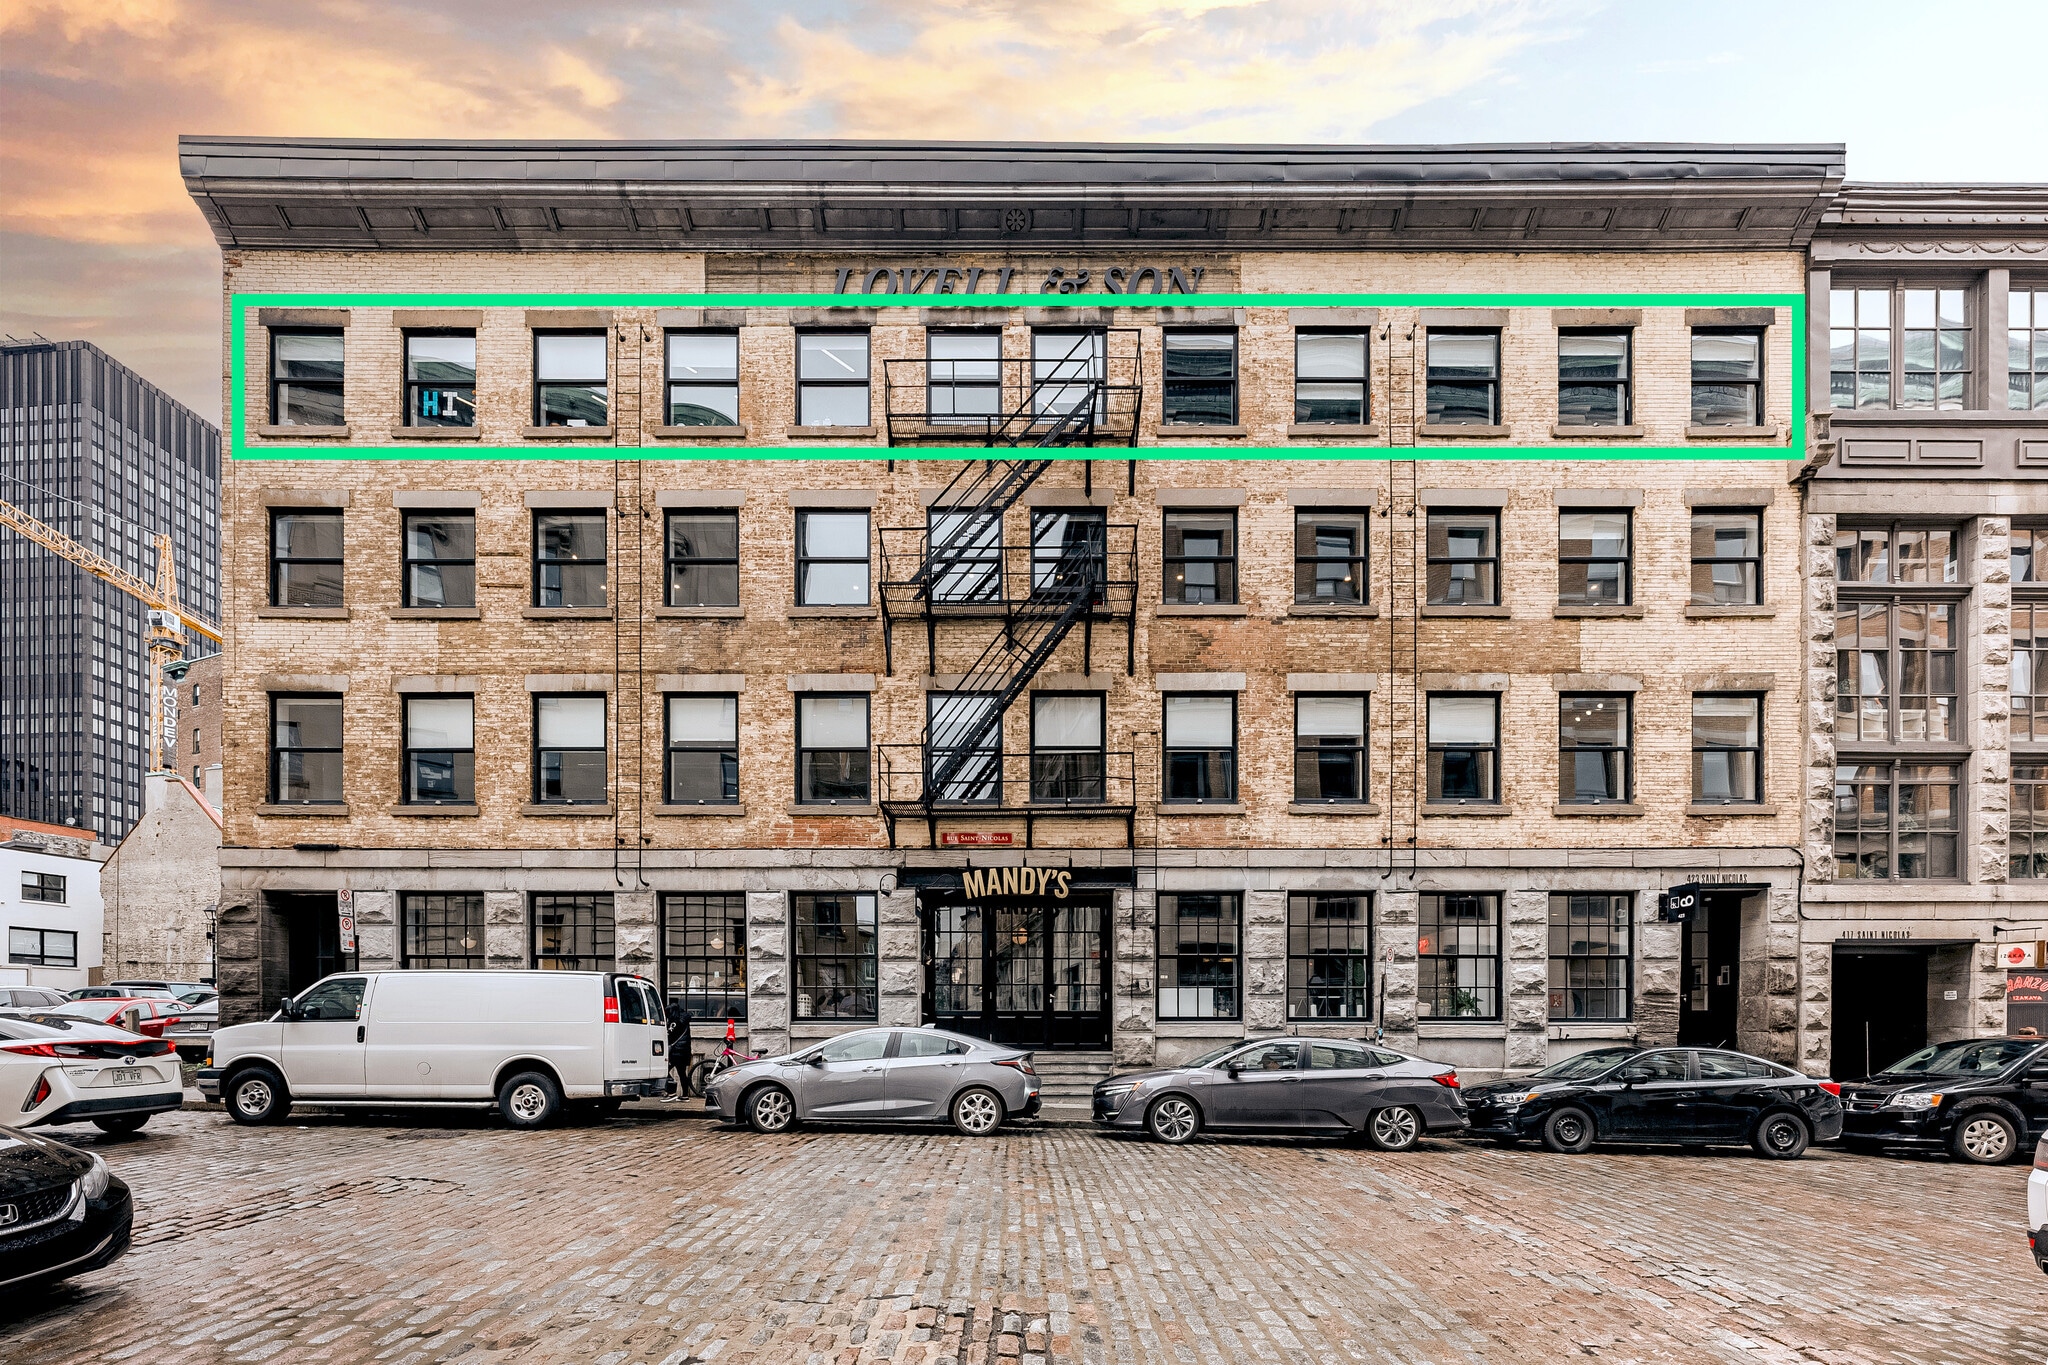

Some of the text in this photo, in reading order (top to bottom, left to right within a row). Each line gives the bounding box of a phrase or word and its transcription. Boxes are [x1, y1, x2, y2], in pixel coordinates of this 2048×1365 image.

[1101, 266, 1204, 308] SON
[423, 391, 457, 416] HI
[163, 686, 177, 747] MONDEV
[962, 867, 1072, 899] MANDY'S
[1701, 874, 1719, 884] SAINT
[1722, 874, 1748, 884] NICOLAS
[1842, 931, 1911, 939] 417 SAINT NICOLAS
